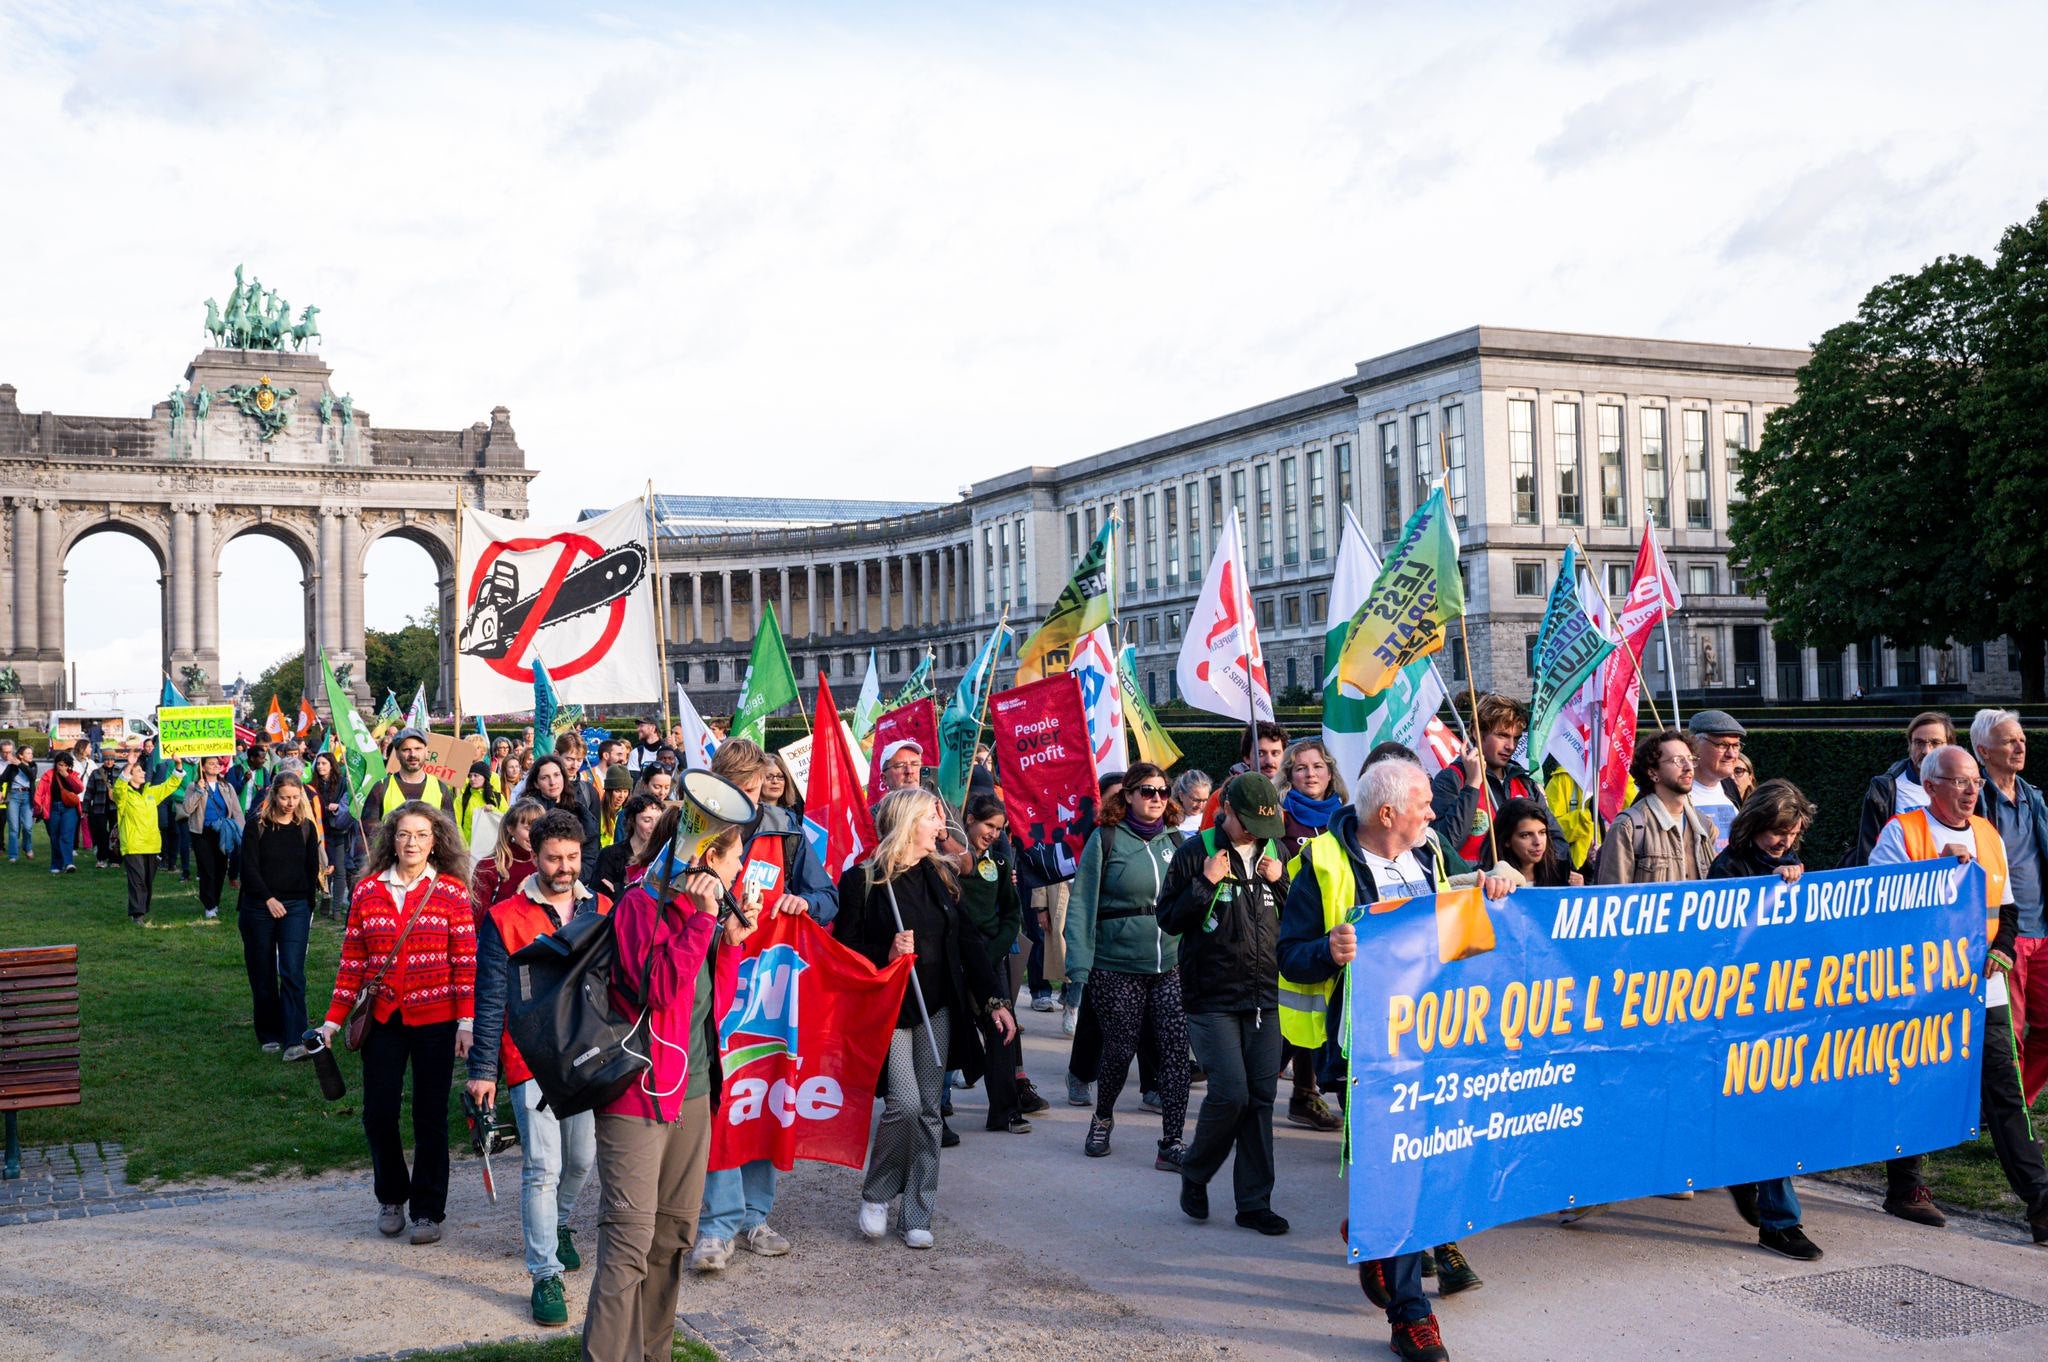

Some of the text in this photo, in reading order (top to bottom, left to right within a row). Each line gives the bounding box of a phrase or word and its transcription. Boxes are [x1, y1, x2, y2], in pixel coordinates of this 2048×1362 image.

[161, 719, 225, 731] JUSTICE
[161, 729, 233, 739] CLIMATIQUE
[1015, 717, 1060, 738] People
[1016, 729, 1061, 753] over
[1019, 744, 1066, 772] profit
[1551, 867, 1959, 940] MARCHE POUR LES DROITS HUMAINS
[1387, 984, 1491, 1057] POUR
[1499, 976, 1575, 1050] QUE
[1764, 957, 1811, 1013] NE
[1814, 943, 1916, 1008] RECULE
[1922, 937, 1978, 995] PAS,
[1722, 1033, 1809, 1096] NOUS
[1810, 1011, 1953, 1085] AVANÇONS
[1463, 1061, 1577, 1101] septembre
